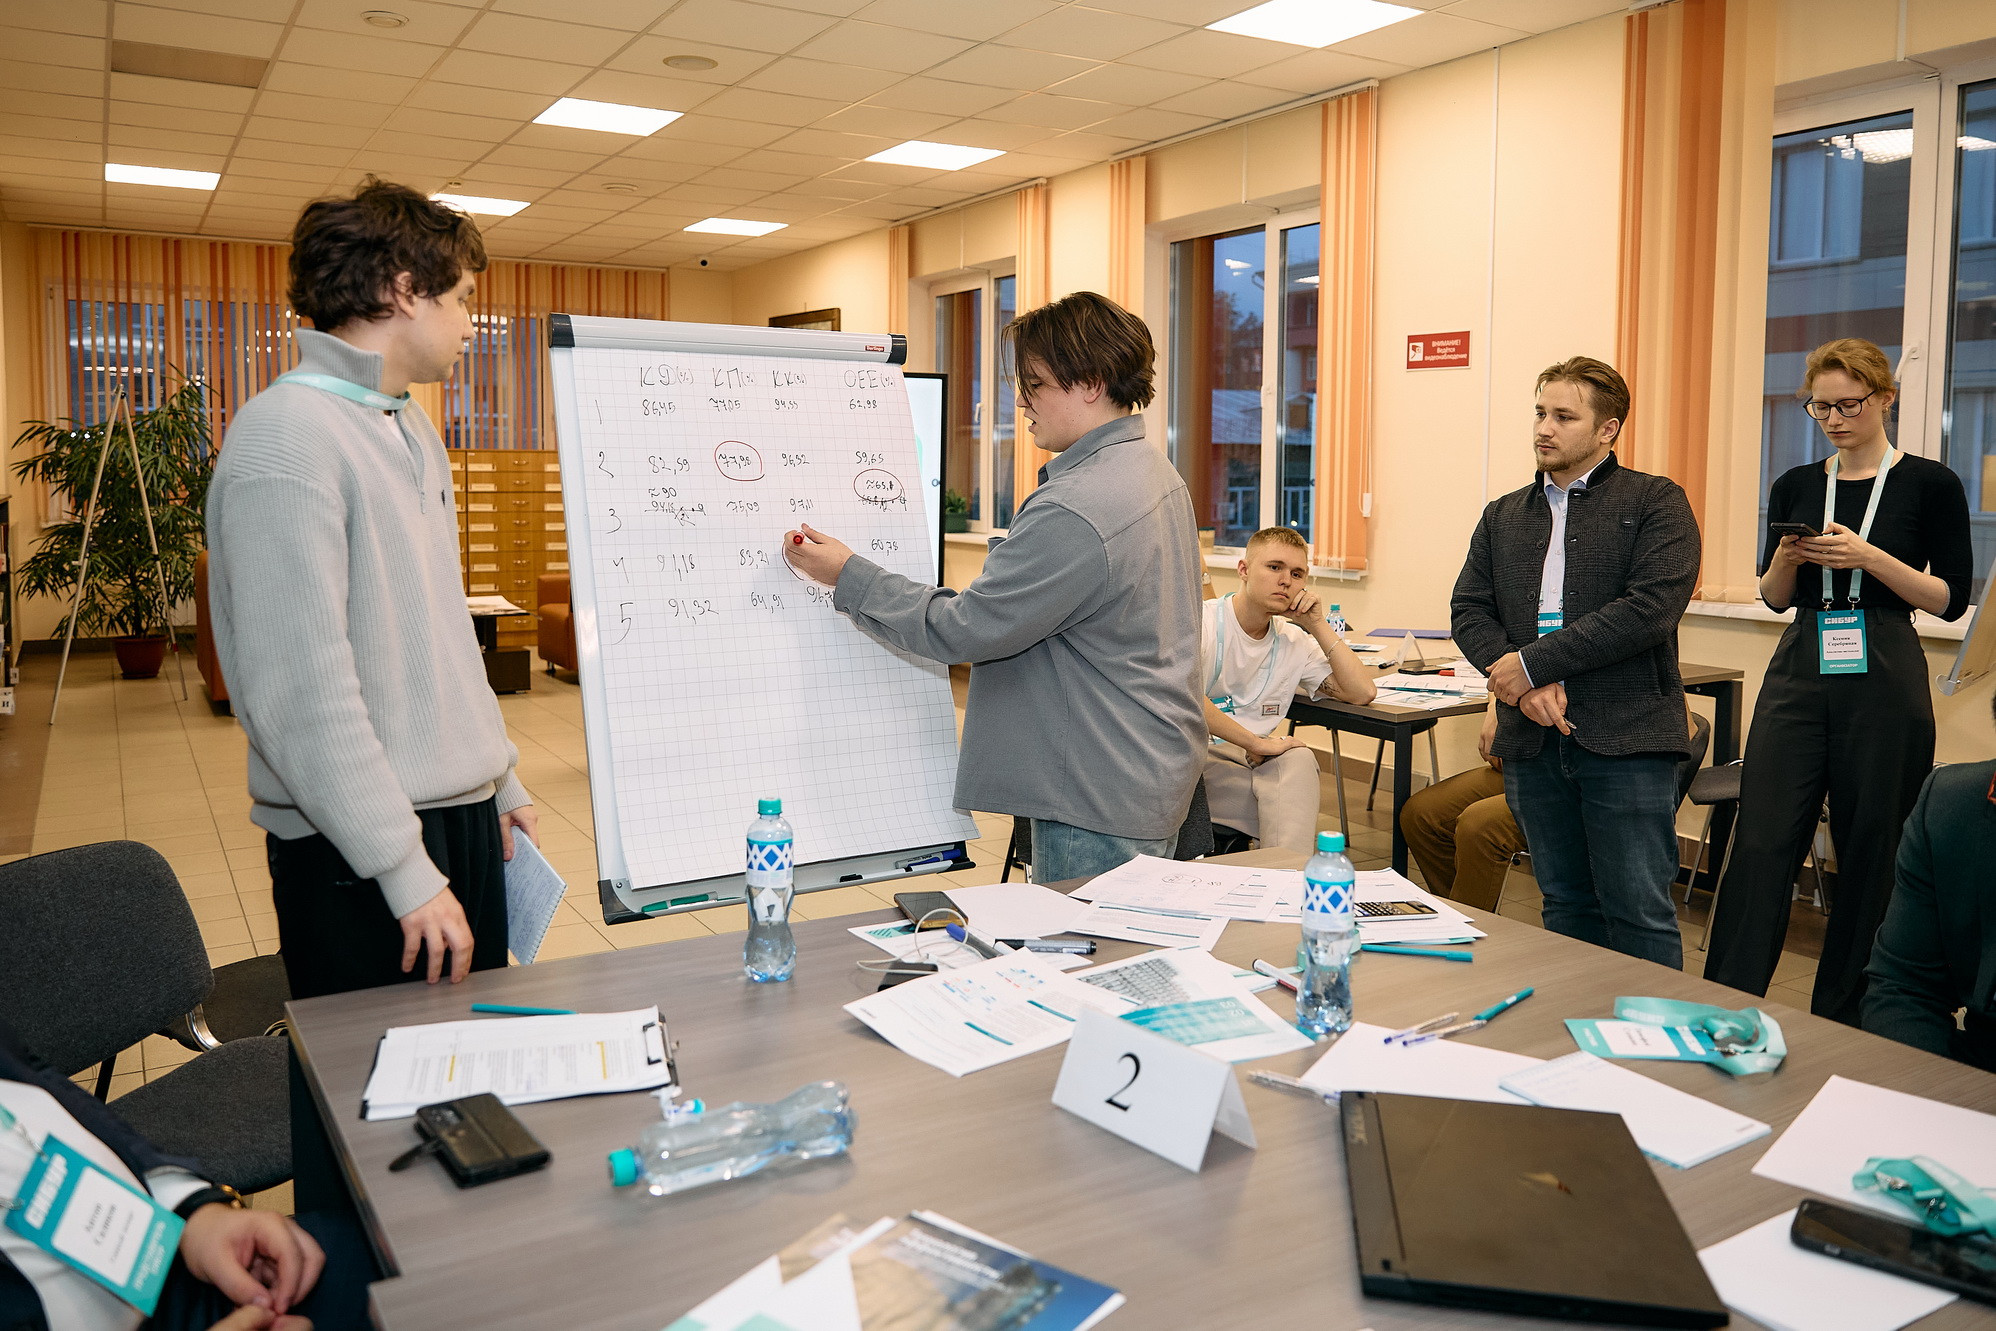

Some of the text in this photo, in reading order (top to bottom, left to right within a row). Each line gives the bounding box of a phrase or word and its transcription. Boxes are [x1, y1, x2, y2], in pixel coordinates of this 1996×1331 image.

[594, 399, 603, 425] 1
[641, 398, 676, 417] 86,45
[598, 450, 615, 479] 2
[647, 454, 691, 476] 82,59
[605, 508, 623, 535] 3
[611, 602, 634, 646] 5
[667, 597, 720, 625] 91,32
[750, 591, 785, 614] 64,91
[1104, 1052, 1142, 1112] 2
